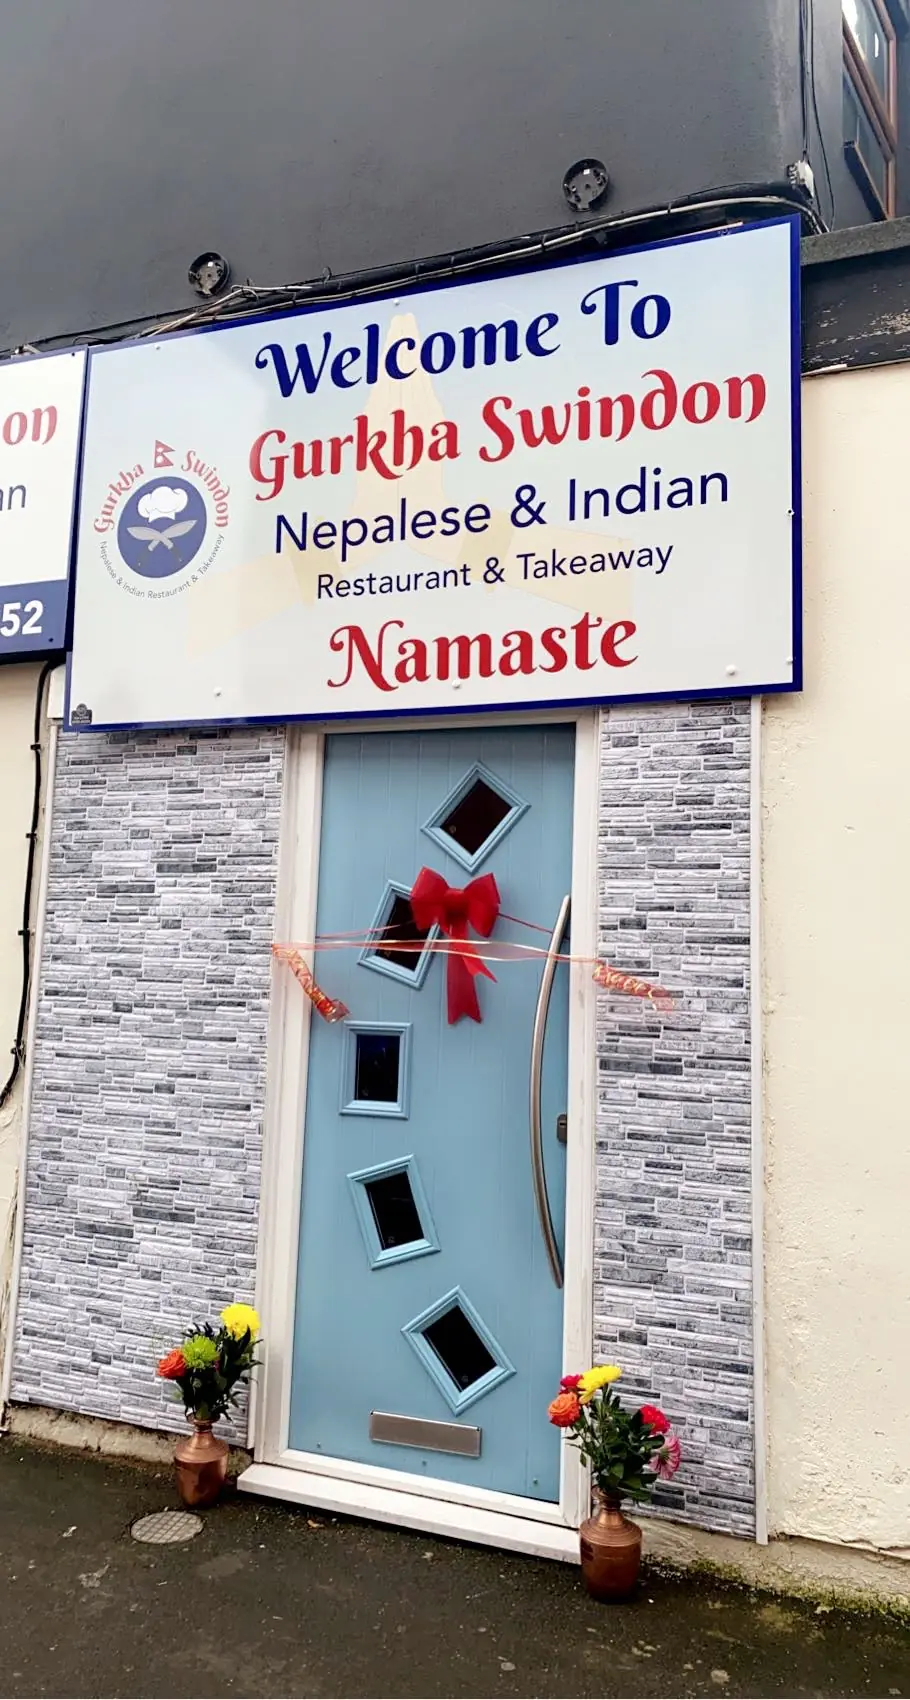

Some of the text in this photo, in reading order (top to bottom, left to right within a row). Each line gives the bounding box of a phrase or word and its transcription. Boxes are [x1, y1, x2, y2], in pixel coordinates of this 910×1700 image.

[255, 279, 672, 398] Welcome To
[2, 405, 58, 446] on
[249, 369, 767, 501] Gurkha Swindon
[93, 450, 230, 533] Gurkha Swindon
[275, 466, 729, 562] Nepalese & Indian
[100, 541, 117, 580] Nepalese
[123, 582, 145, 598] Indian
[147, 582, 191, 599] Restaurant
[197, 534, 225, 576] Takeaway
[316, 543, 674, 600] Restaurant & Takeaway
[0, 600, 44, 637] 52
[327, 612, 639, 692] Namaste
